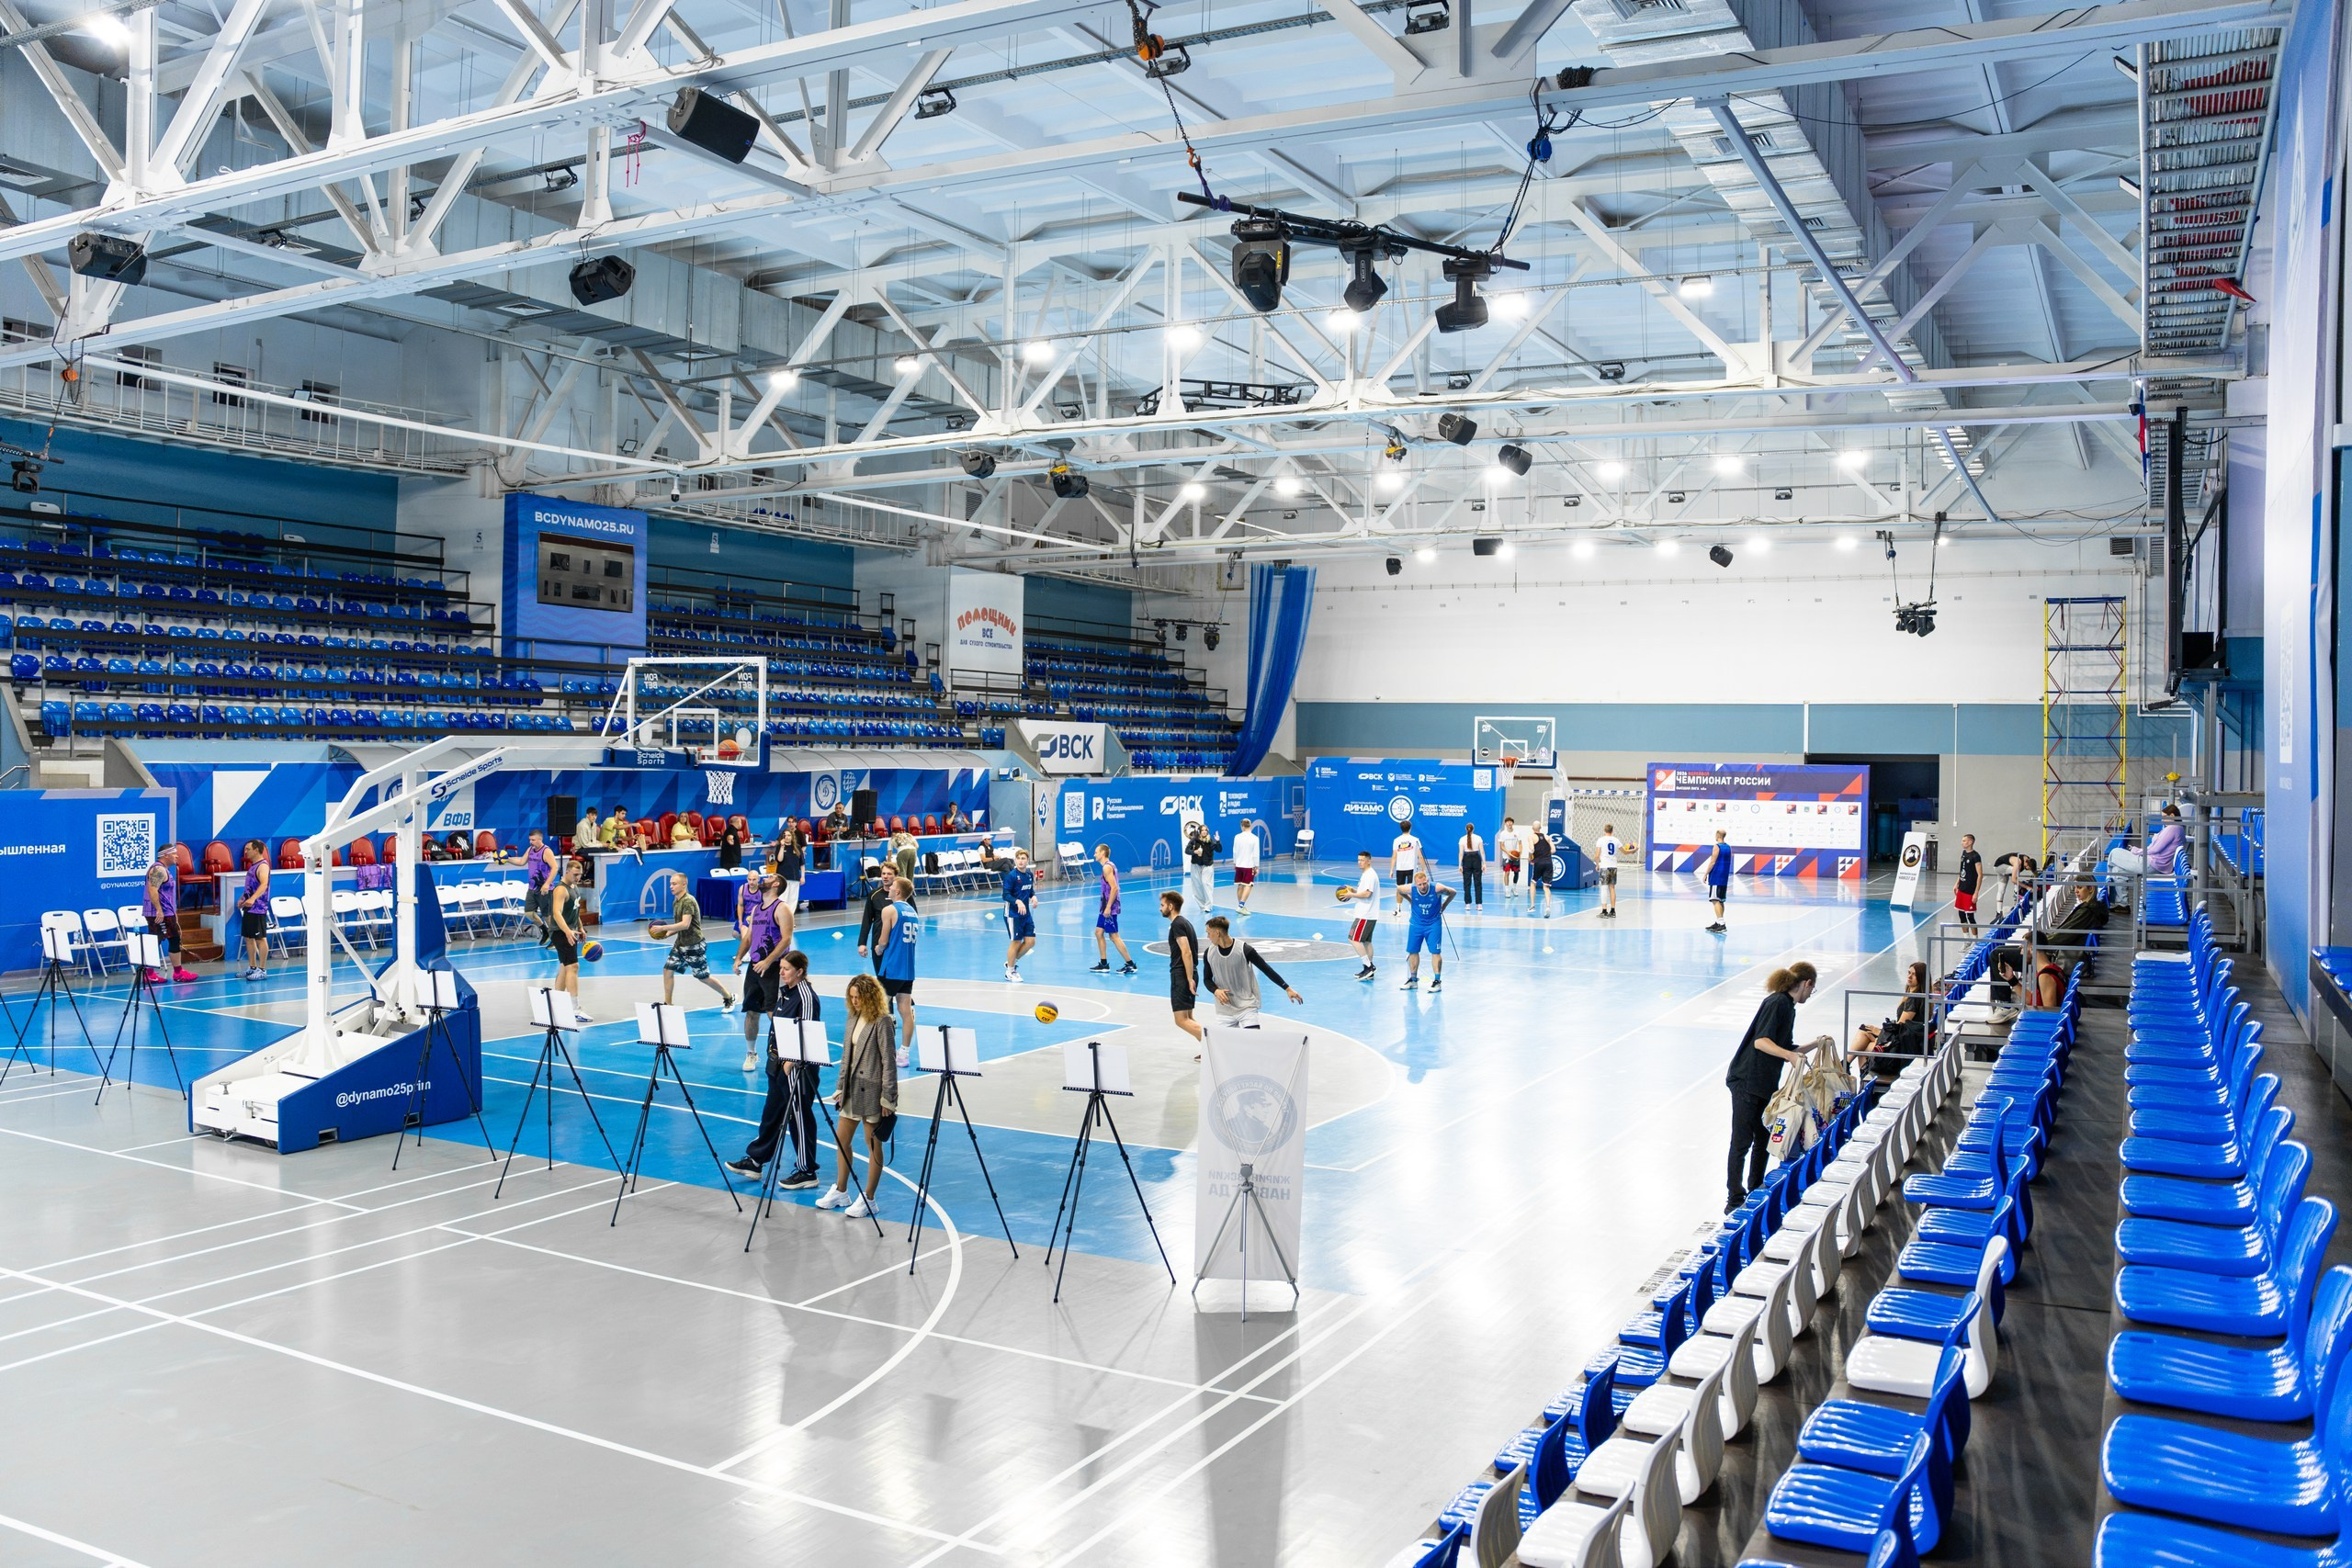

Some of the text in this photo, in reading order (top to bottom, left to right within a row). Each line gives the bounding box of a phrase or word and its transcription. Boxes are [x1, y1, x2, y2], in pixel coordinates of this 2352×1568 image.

[535, 511, 634, 535] BCDYNAMO25.RU
[476, 532, 482, 543] 5
[957, 607, 1016, 637] ПОМОЩНИК
[982, 628, 993, 638] ВСЕ
[1059, 734, 1094, 761] ВСК
[478, 756, 502, 772] Sports
[1676, 776, 1771, 786] ЧЕМПИОНАТ РОССИИ
[1179, 795, 1203, 812] ВСК
[1344, 804, 1384, 812] ДИНАМО
[443, 813, 471, 826] ВФВ
[1608, 843, 1615, 855] 9
[101, 880, 146, 889] @DYNAMO25PR
[903, 922, 918, 944] 95
